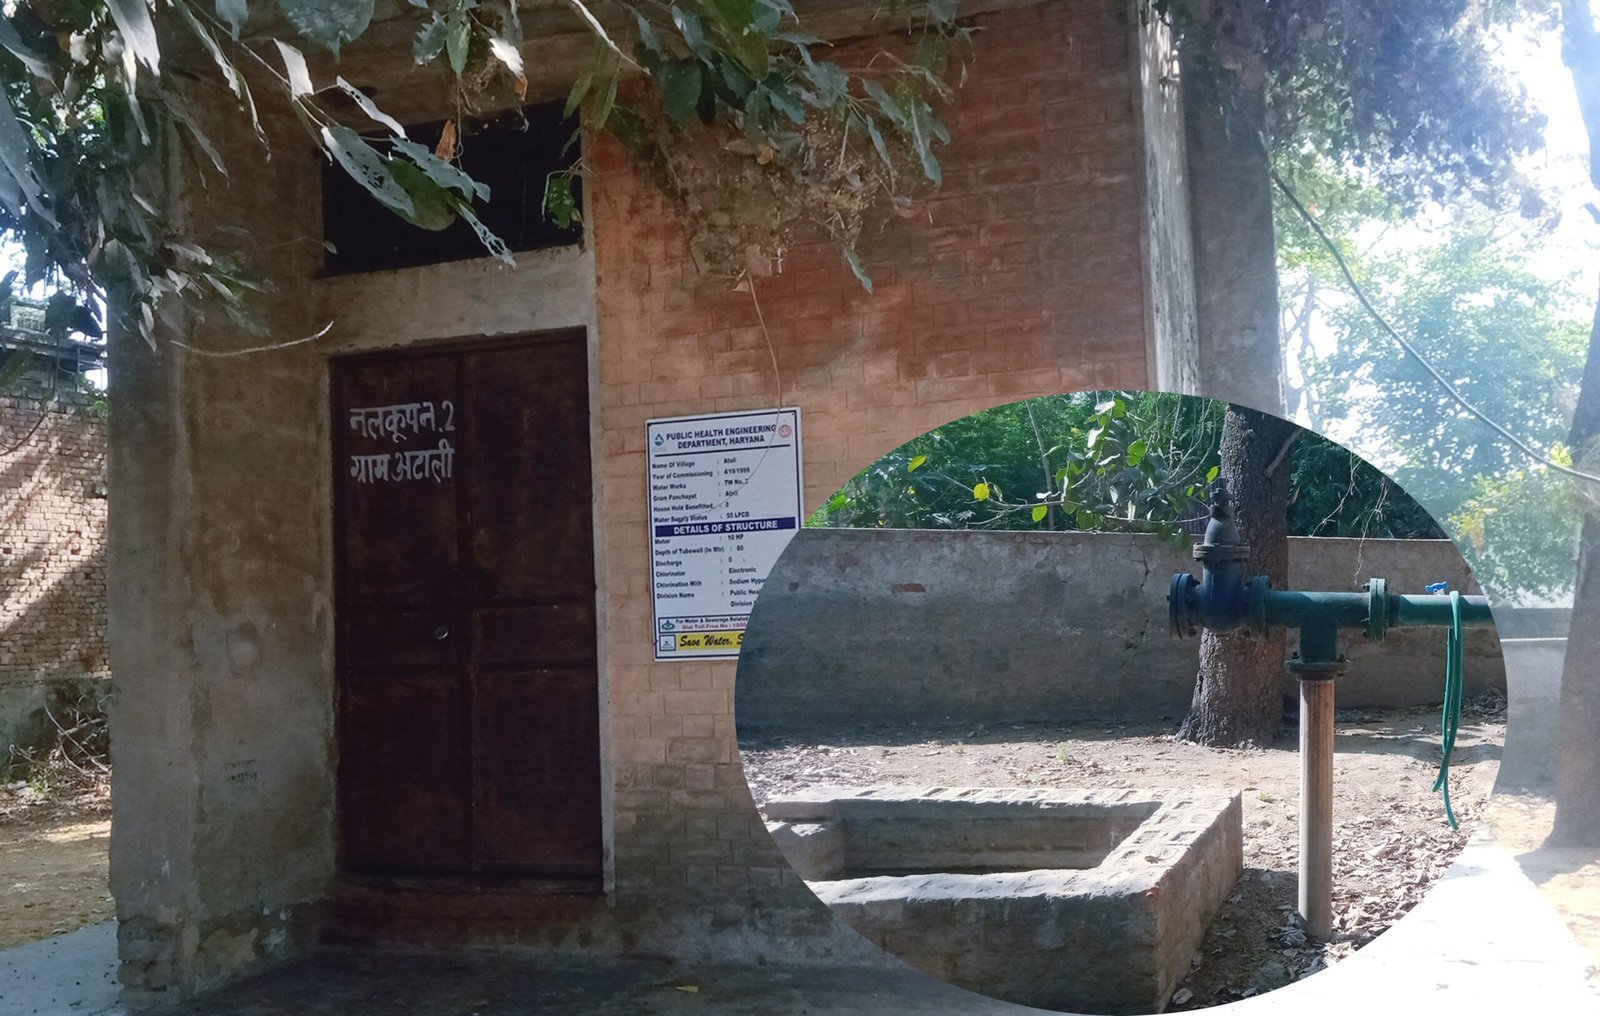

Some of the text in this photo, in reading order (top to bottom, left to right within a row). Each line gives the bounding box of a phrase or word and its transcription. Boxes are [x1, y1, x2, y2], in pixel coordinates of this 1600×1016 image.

[666, 424, 777, 441] PUBLIC HEALTH ENGINEERING
[677, 435, 765, 449] DEPARTMENT, HARYANA
[672, 470, 712, 478] Commissioning
[668, 493, 697, 501] Panchayat
[673, 520, 778, 535] DETAILS OF STRUCTURE
[680, 635, 701, 647] Save
